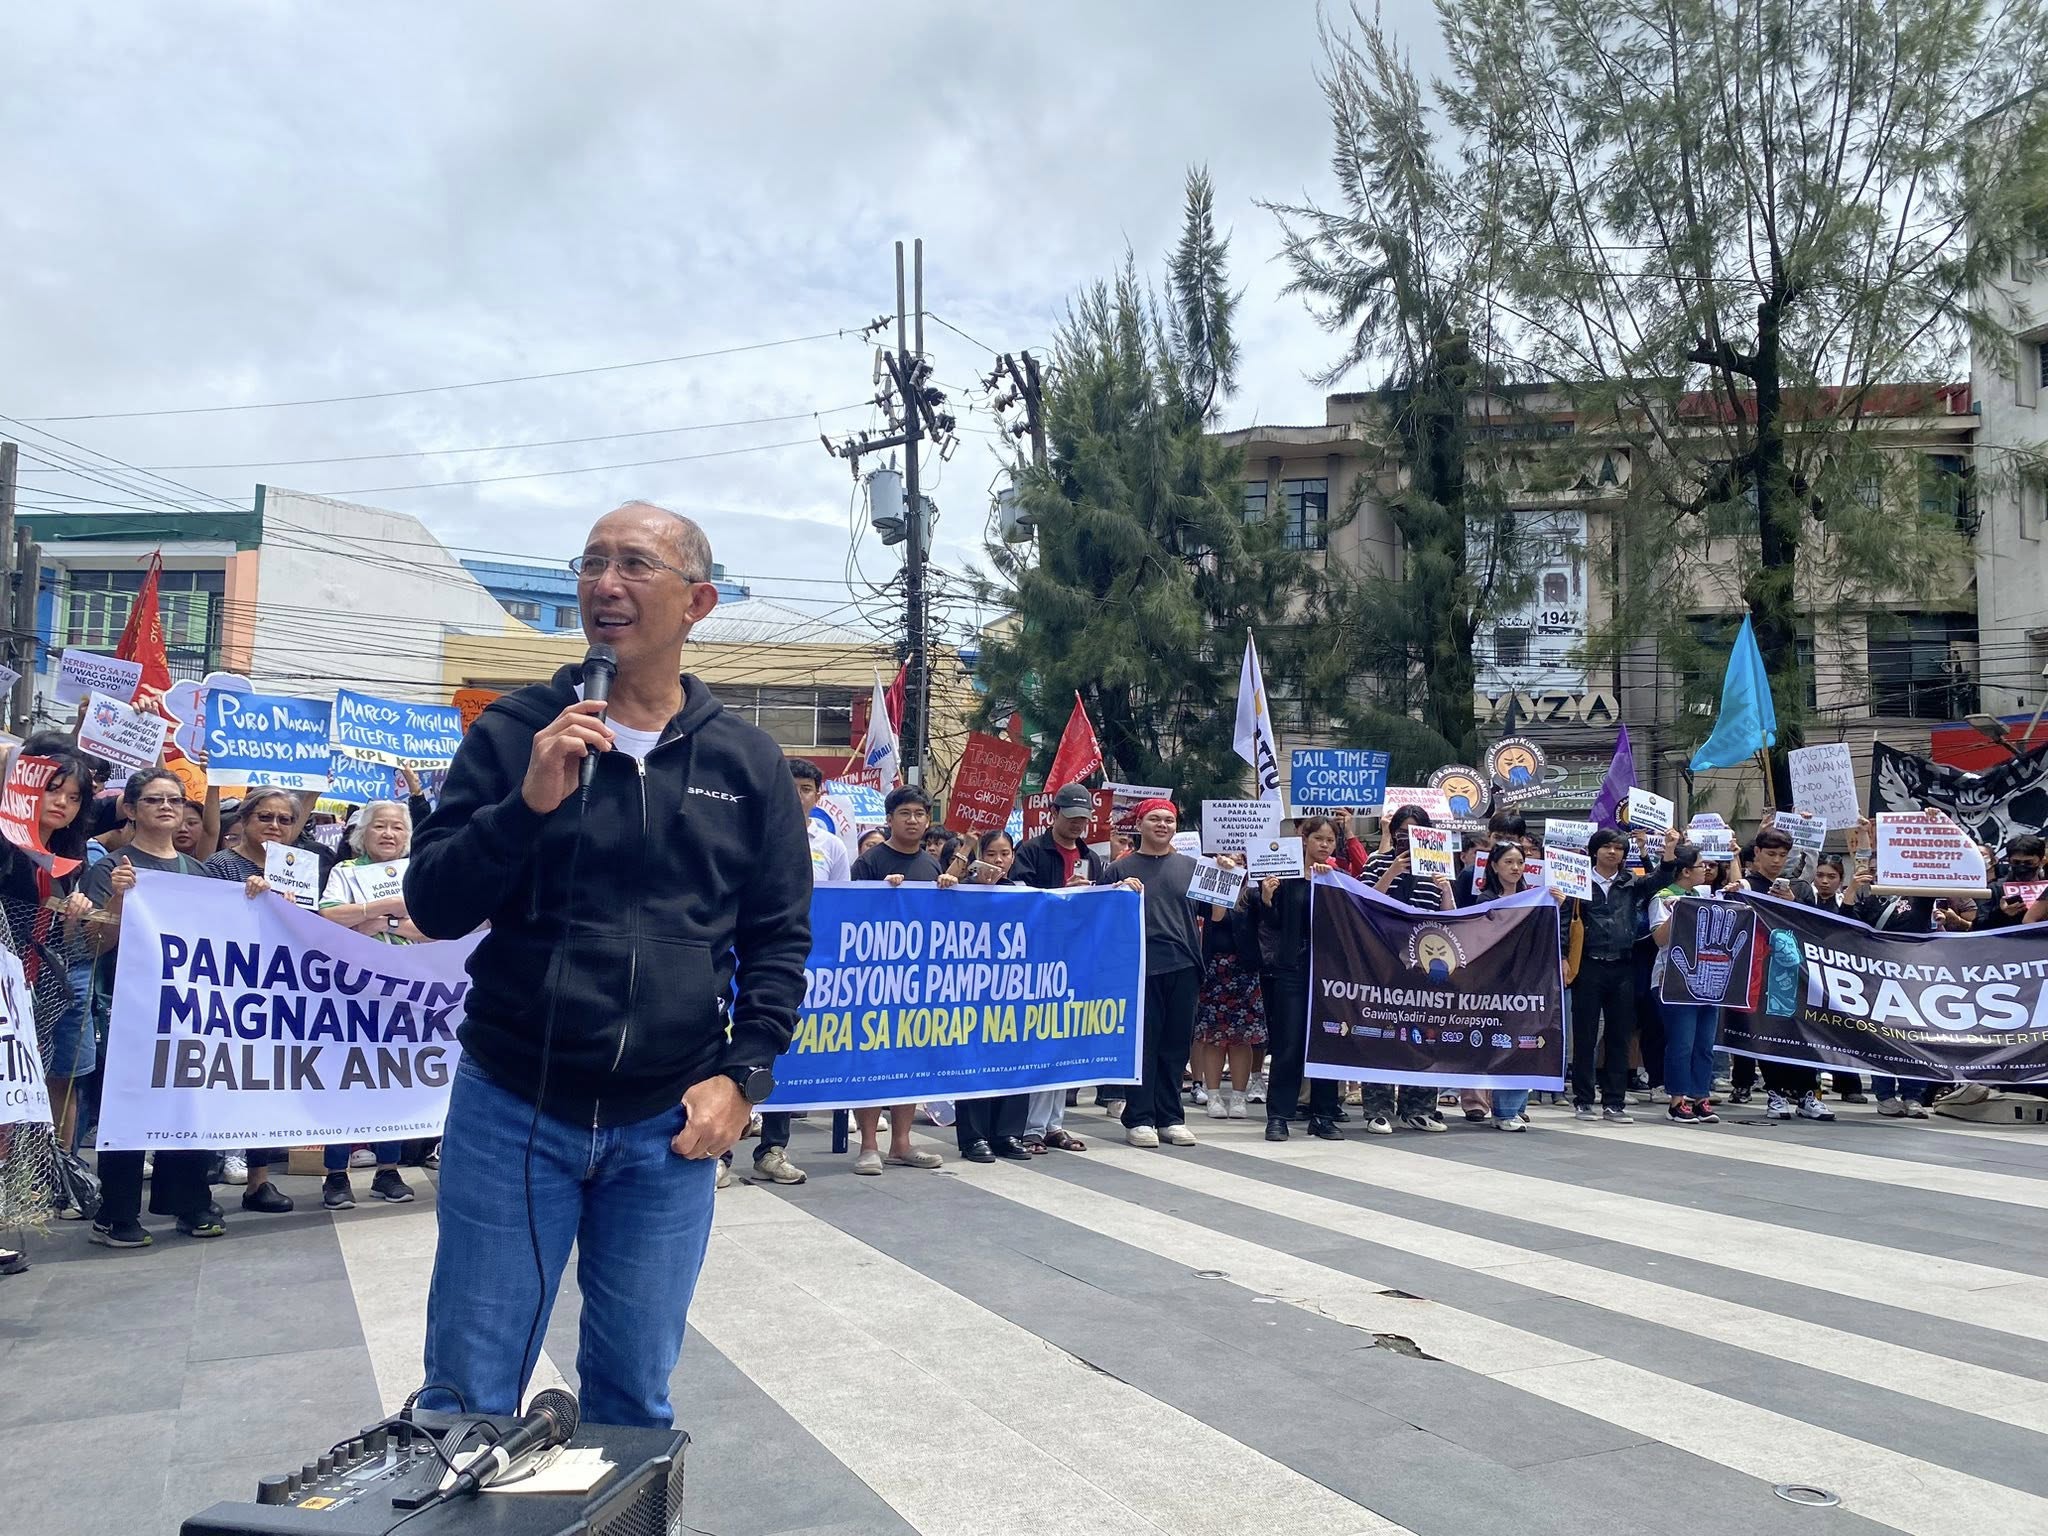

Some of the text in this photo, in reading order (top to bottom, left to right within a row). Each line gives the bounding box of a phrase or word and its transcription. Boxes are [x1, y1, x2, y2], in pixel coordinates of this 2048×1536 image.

[1540, 611, 1579, 625] 1947
[62, 665, 137, 687] HUWAG GAWING
[63, 657, 119, 676] SERBISYO SA
[75, 677, 121, 691] NEGOSYO!
[217, 693, 269, 731] PURO
[340, 696, 400, 725] MARCOS
[405, 708, 460, 733] SINGILIN
[118, 719, 160, 739] PANAGUTIN
[137, 717, 161, 731] DAPAT
[102, 730, 134, 746] WALANG
[121, 730, 156, 747] ANG MGA
[210, 730, 294, 762] SERBISYO,
[1490, 738, 1519, 754] AGAINST
[355, 749, 387, 762] KPL
[1292, 751, 1387, 768] JAIL TIME FOR
[1488, 755, 1497, 778] YOUTH
[1803, 760, 1850, 776] NAMAN NG
[247, 775, 304, 788] AB-MB
[331, 776, 390, 799] ATAKOT!
[1306, 770, 1379, 787] CORRUPT
[1437, 767, 1489, 804] AGAINST KURAKOT!
[1792, 781, 1822, 793] PONDO
[687, 786, 747, 803] SPACEX
[974, 789, 1009, 809] GHOST
[1298, 787, 1378, 803] OFFICIALS!
[955, 803, 1000, 826] PROJECTS
[1357, 807, 1372, 816] MB
[1636, 803, 1654, 812] KADIRI
[1435, 823, 1487, 831] KORAPSYON!
[1882, 815, 1938, 825] FILIPINO
[1896, 826, 1922, 835] FOR
[1888, 838, 1973, 849] MANSIONS &
[1218, 870, 1243, 887] RIVERS
[1882, 871, 1981, 881] #magnanakaw
[839, 920, 1027, 963] PONDO PARA SA
[1408, 920, 1467, 969] YOUTH AGAINST KURAKOT!
[159, 932, 468, 1006] PANAGUTIN
[1803, 942, 1957, 983] BURUKRATA
[797, 960, 1075, 1010] RBISYONG PAMPUBLIKO,
[1322, 979, 1545, 1012] YOUTH AGAINST KURAKOT!
[157, 985, 460, 1044] MAGNANAK
[1362, 1007, 1503, 1028] Gawing Kadiri ang Korapsyon.
[859, 1010, 891, 1051] SA
[896, 1007, 977, 1050] KORAP
[982, 1004, 1018, 1044] NA
[1023, 998, 1126, 1042] PULITIKO!
[1804, 1009, 2048, 1046] MARCOS DUTERTE
[1758, 1035, 1801, 1046] ANAKBAYAN
[1807, 1042, 1831, 1051] METRO
[1832, 1046, 1860, 1055] BAGUIO
[1883, 1056, 1928, 1066] CORDILLERA
[151, 1039, 450, 1091] IBALIK ANG
[815, 1077, 843, 1085] BAGUIO
[851, 1075, 866, 1083] ACT
[868, 1073, 909, 1082] CORDILLERA
[937, 1068, 977, 1078] CORDILLERA
[982, 1065, 1017, 1074] KABATAAN
[1018, 1063, 1051, 1072] PARTYLIST
[1055, 1058, 1090, 1067] CORDILLERA
[146, 1121, 433, 1140] TTU-CPA METRO BAGUIO ACT CORDILLERA
